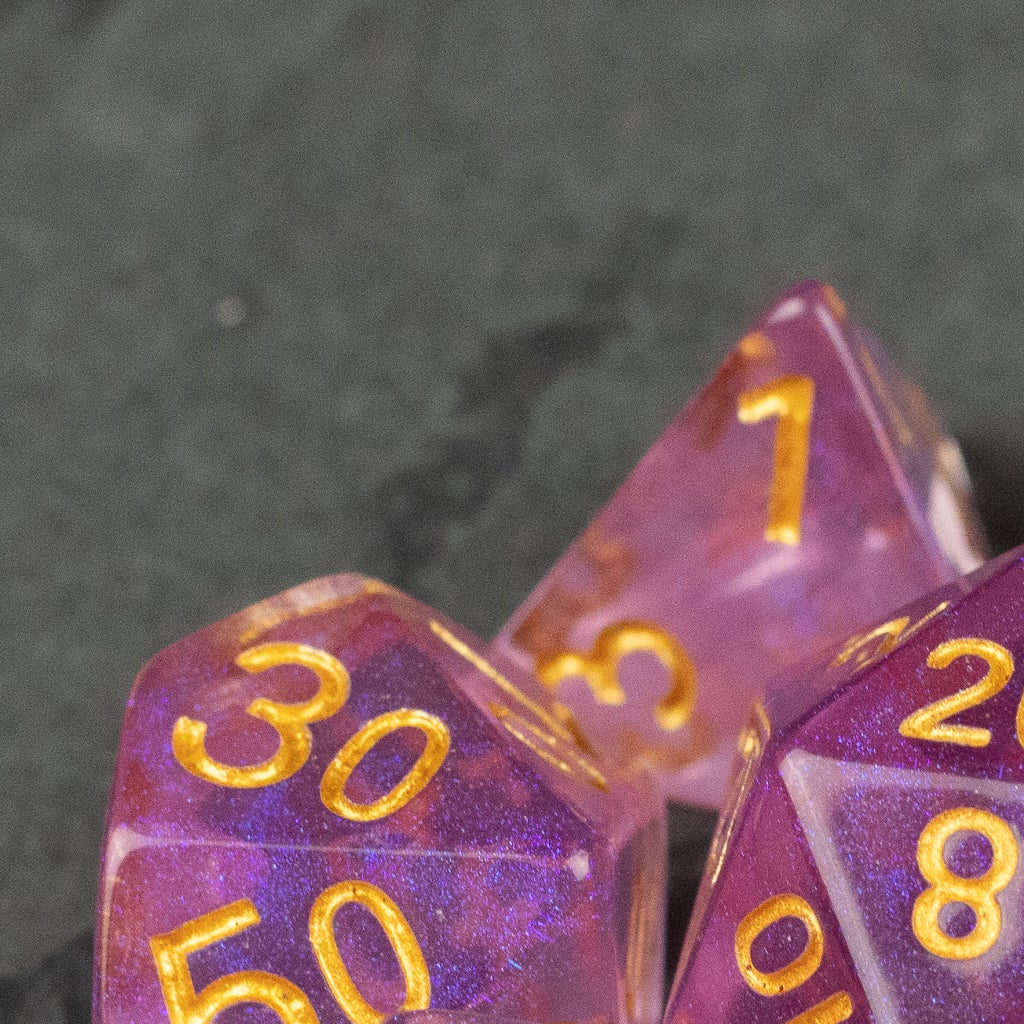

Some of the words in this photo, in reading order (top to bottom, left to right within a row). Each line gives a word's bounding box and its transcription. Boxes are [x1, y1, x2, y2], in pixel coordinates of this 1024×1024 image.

[736, 375, 815, 547] 1
[171, 641, 451, 822] 30
[912, 806, 1019, 960] 8
